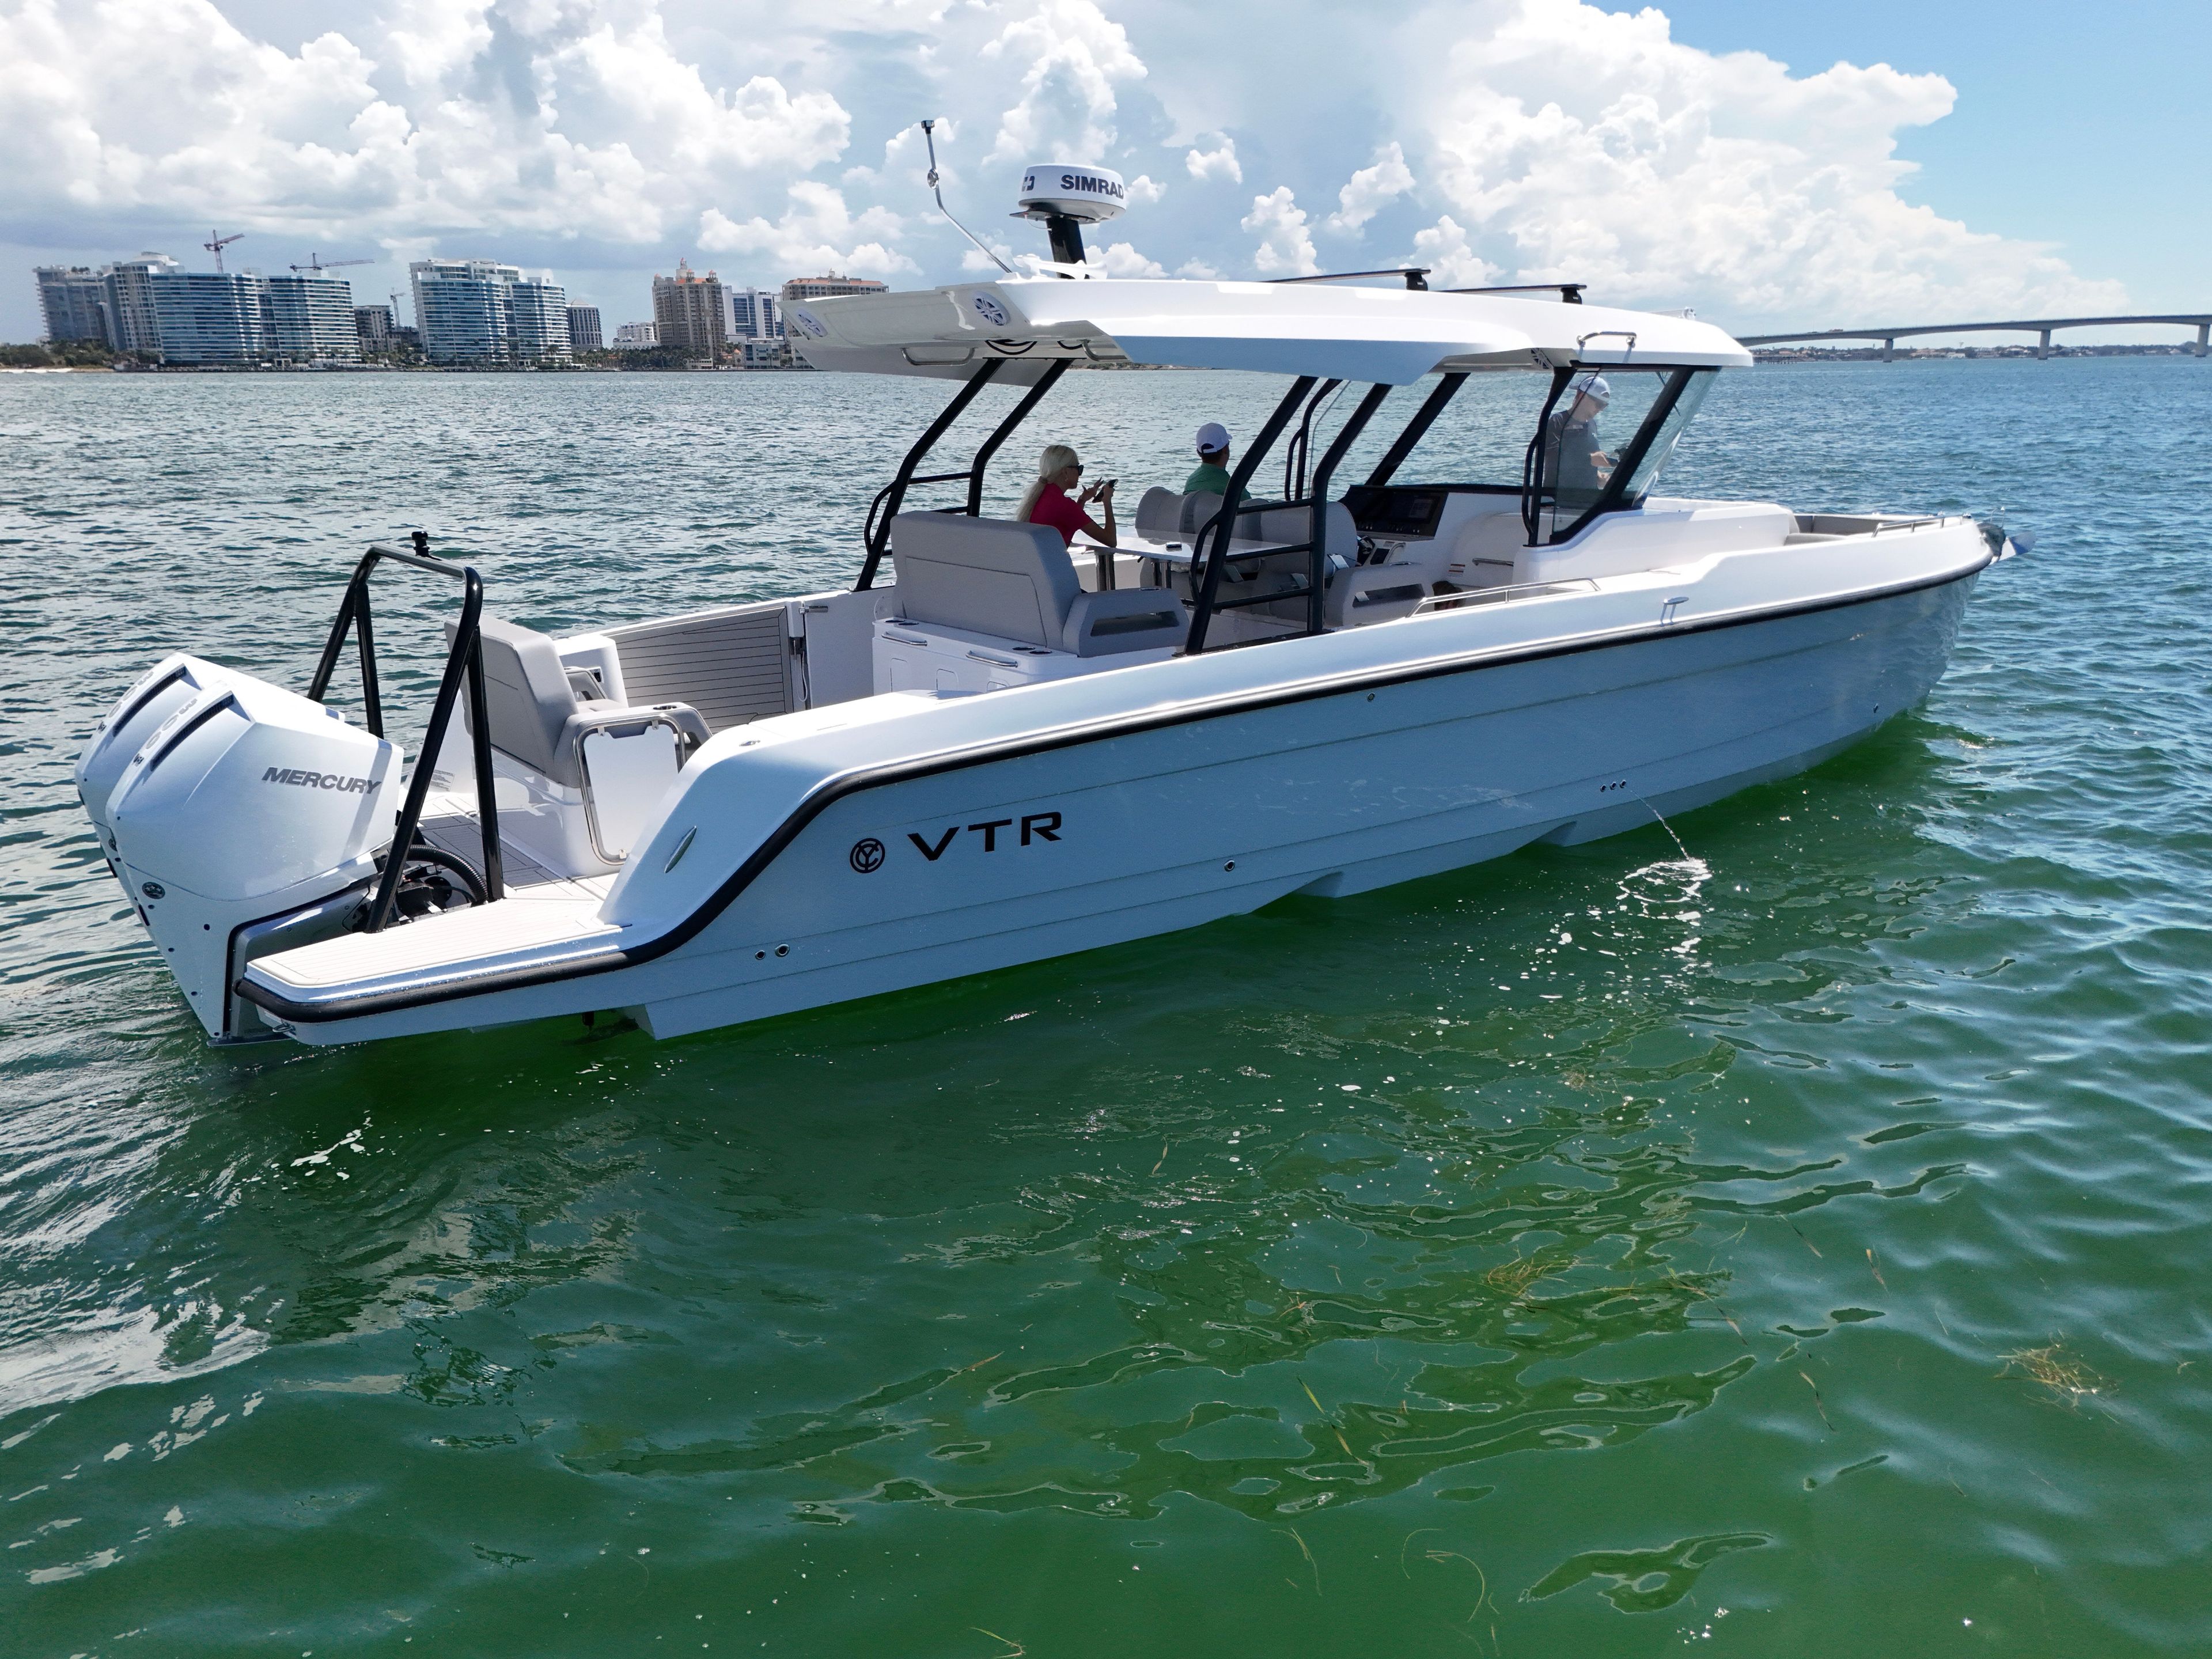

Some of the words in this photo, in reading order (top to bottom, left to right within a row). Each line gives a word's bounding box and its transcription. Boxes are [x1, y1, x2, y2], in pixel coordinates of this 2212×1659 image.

[1060, 175, 1124, 199] SIMRAD
[261, 767, 382, 794] MERCURY
[907, 811, 1062, 861] VTR
